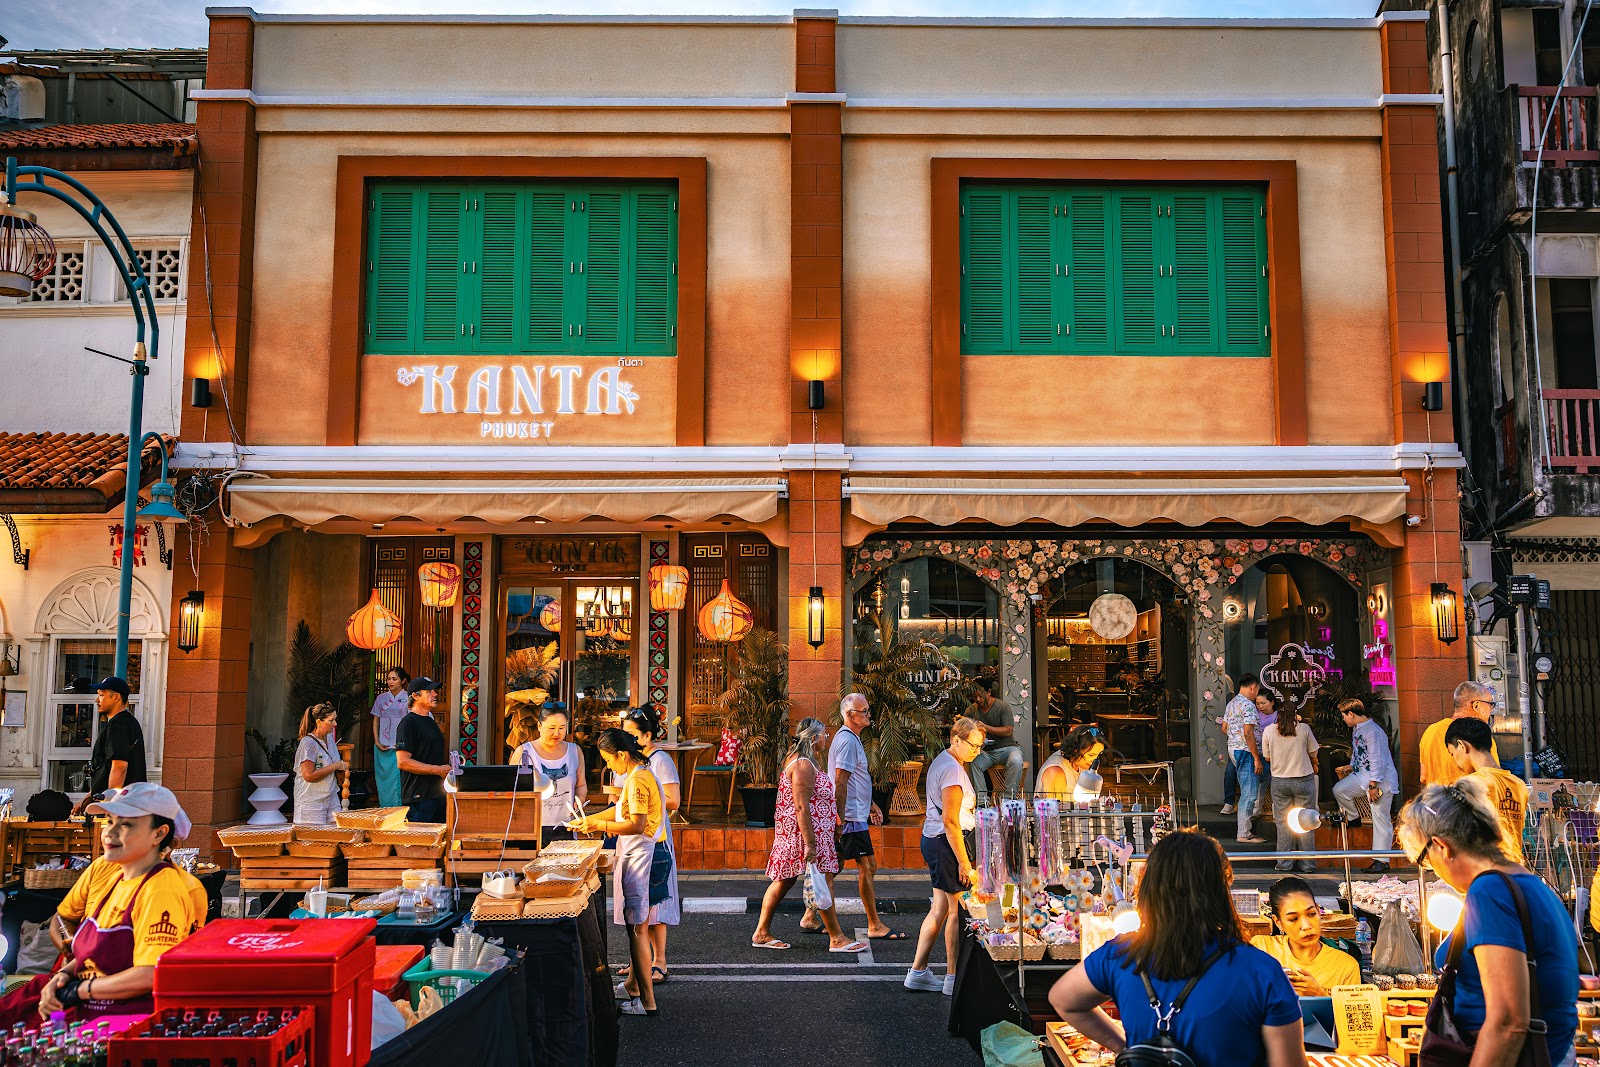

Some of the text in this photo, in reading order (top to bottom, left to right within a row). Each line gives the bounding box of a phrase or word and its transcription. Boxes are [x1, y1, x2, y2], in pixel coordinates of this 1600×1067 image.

[617, 356, 644, 368] กันตา
[419, 365, 624, 415] KANTA
[480, 421, 555, 438] PHUKET
[524, 540, 620, 564] KANTA
[551, 563, 588, 572] PHUKET
[1268, 669, 1320, 683] KANTA
